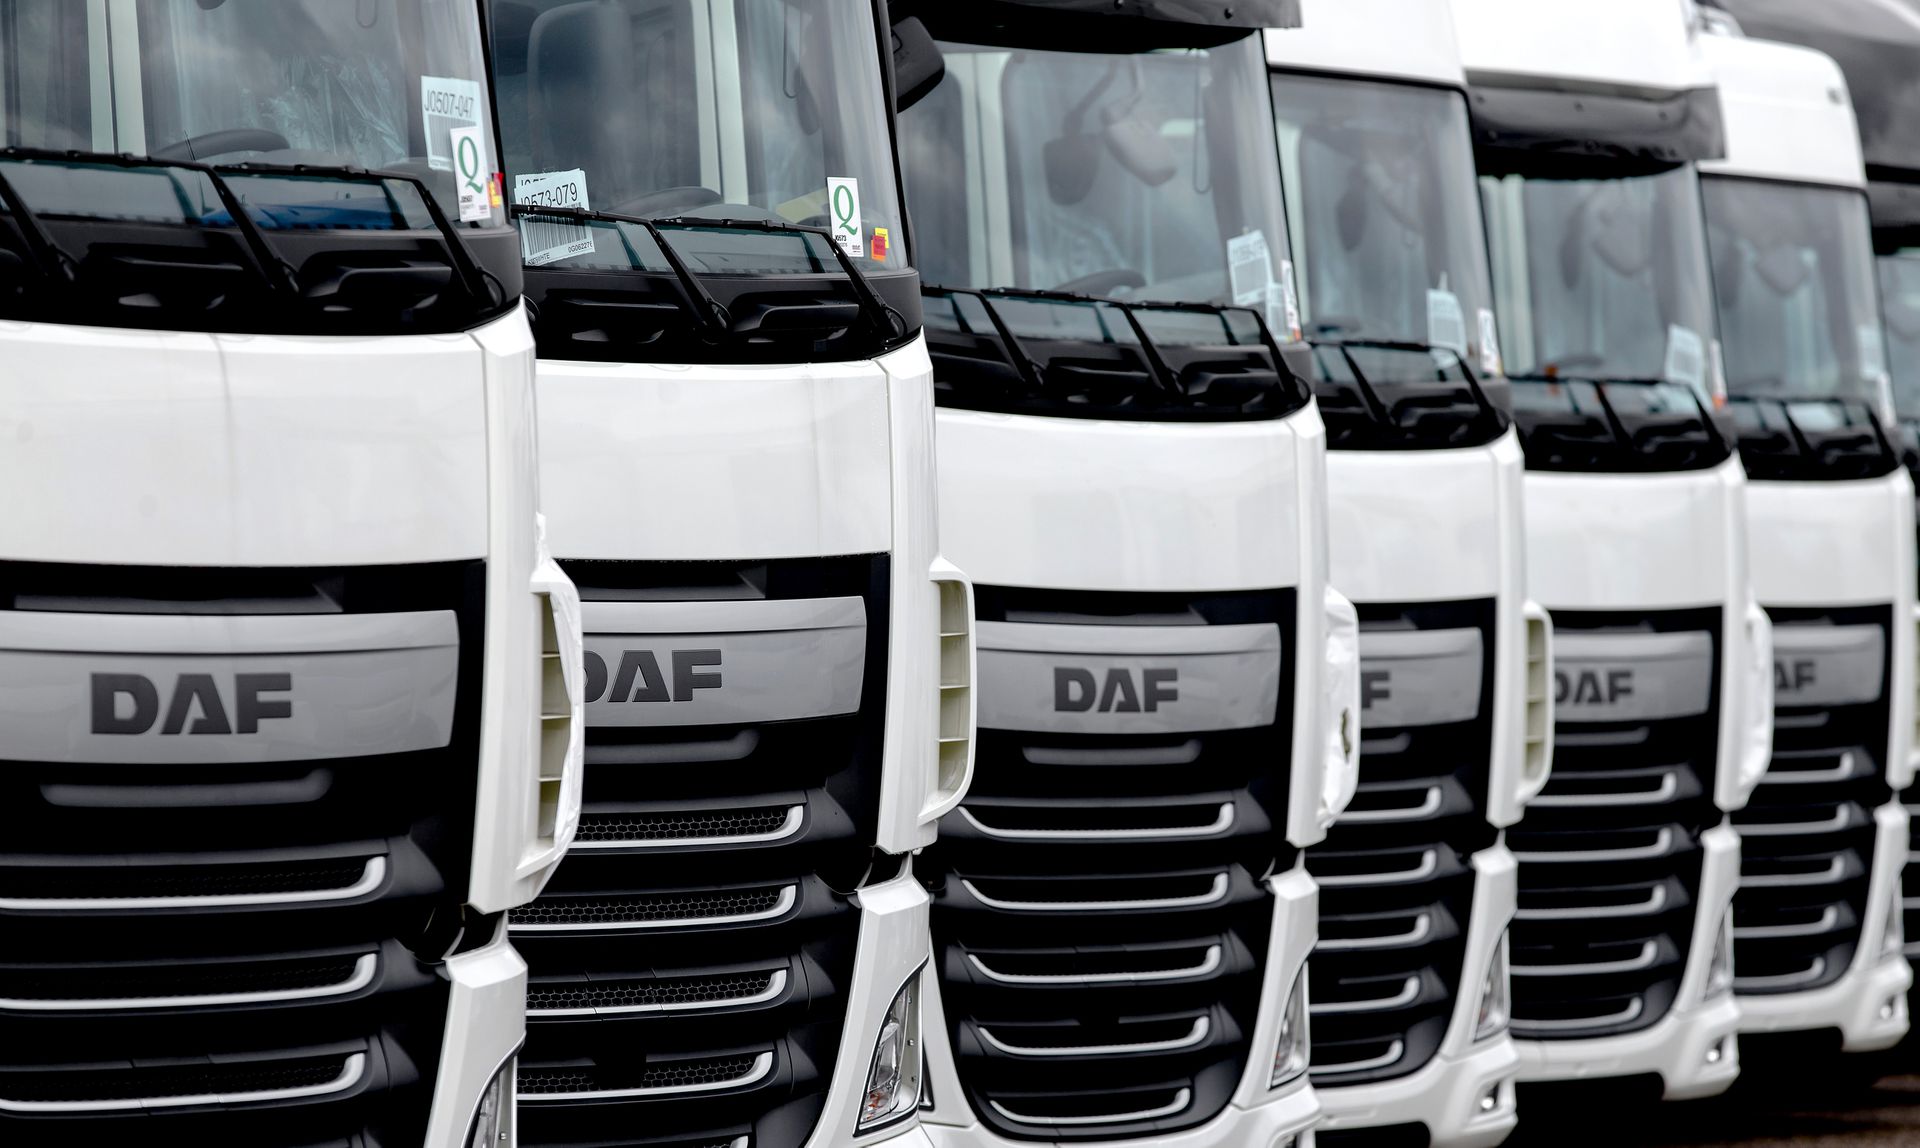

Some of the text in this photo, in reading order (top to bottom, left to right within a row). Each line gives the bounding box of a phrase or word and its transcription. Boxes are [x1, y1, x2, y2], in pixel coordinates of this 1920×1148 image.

[424, 90, 474, 118] J0507-047
[458, 136, 483, 194] Q
[833, 184, 858, 235] Q
[1054, 667, 1179, 713] DAF
[1774, 660, 1815, 690] AF
[90, 672, 292, 735] DAF
